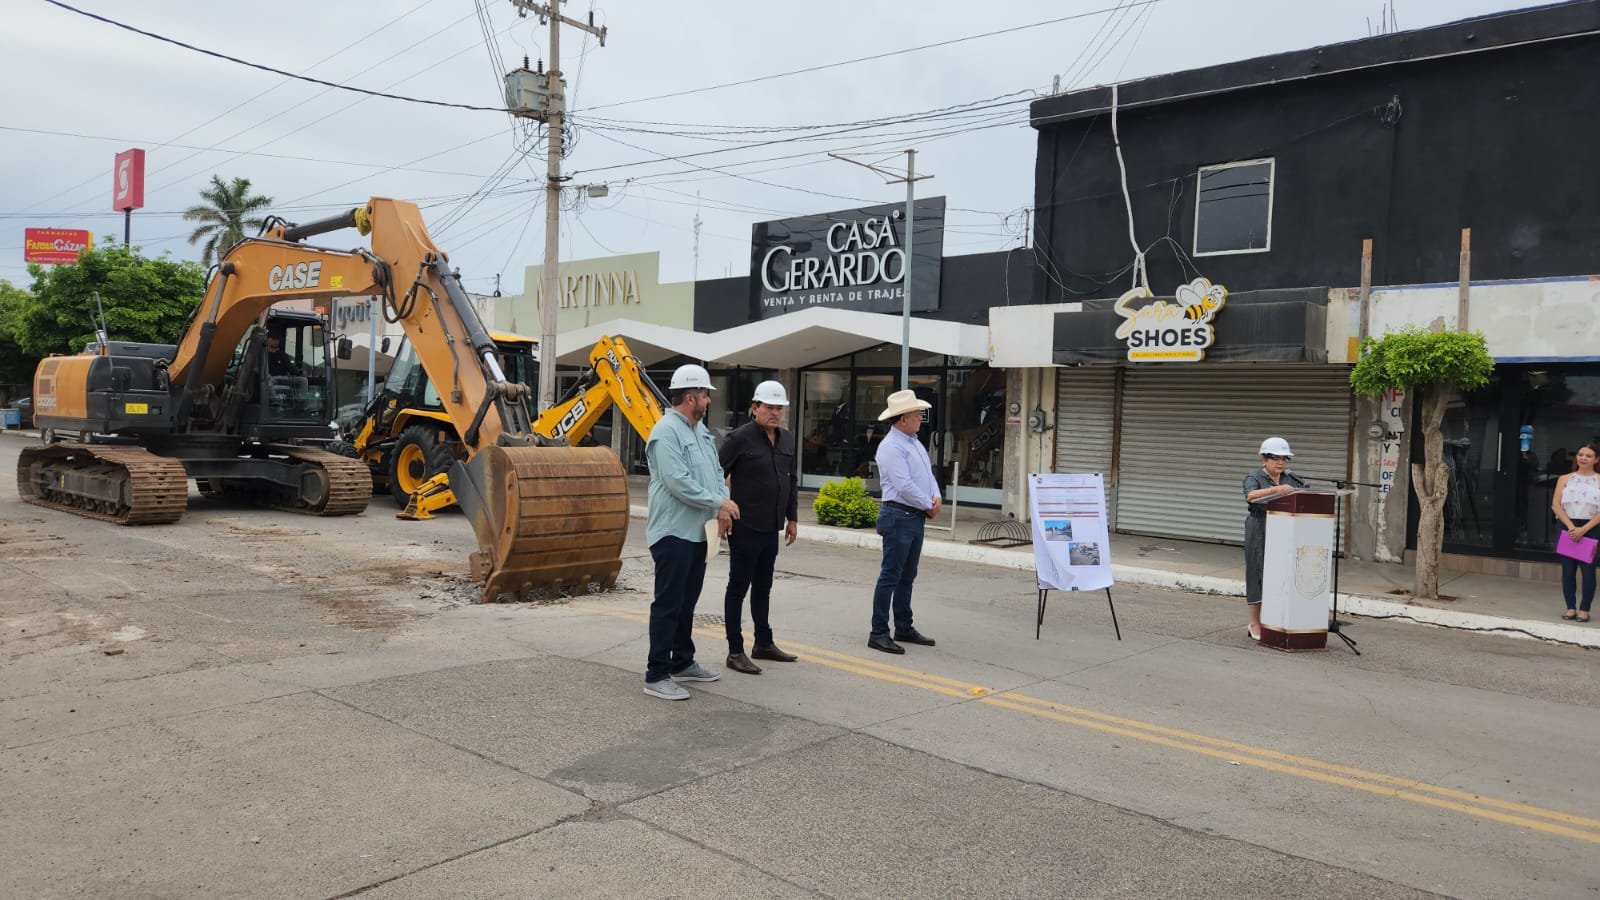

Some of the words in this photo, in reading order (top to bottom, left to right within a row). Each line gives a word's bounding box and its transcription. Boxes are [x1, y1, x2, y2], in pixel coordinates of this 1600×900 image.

[827, 216, 896, 253] CASA
[269, 260, 322, 292] CASE
[761, 245, 906, 293] GERARDO
[764, 297, 795, 307] VENTA
[799, 296, 806, 305] Y
[809, 292, 844, 304] RENTA
[849, 290, 863, 301] DE
[1130, 328, 1208, 347] SHOES
[552, 400, 587, 439] JCB
